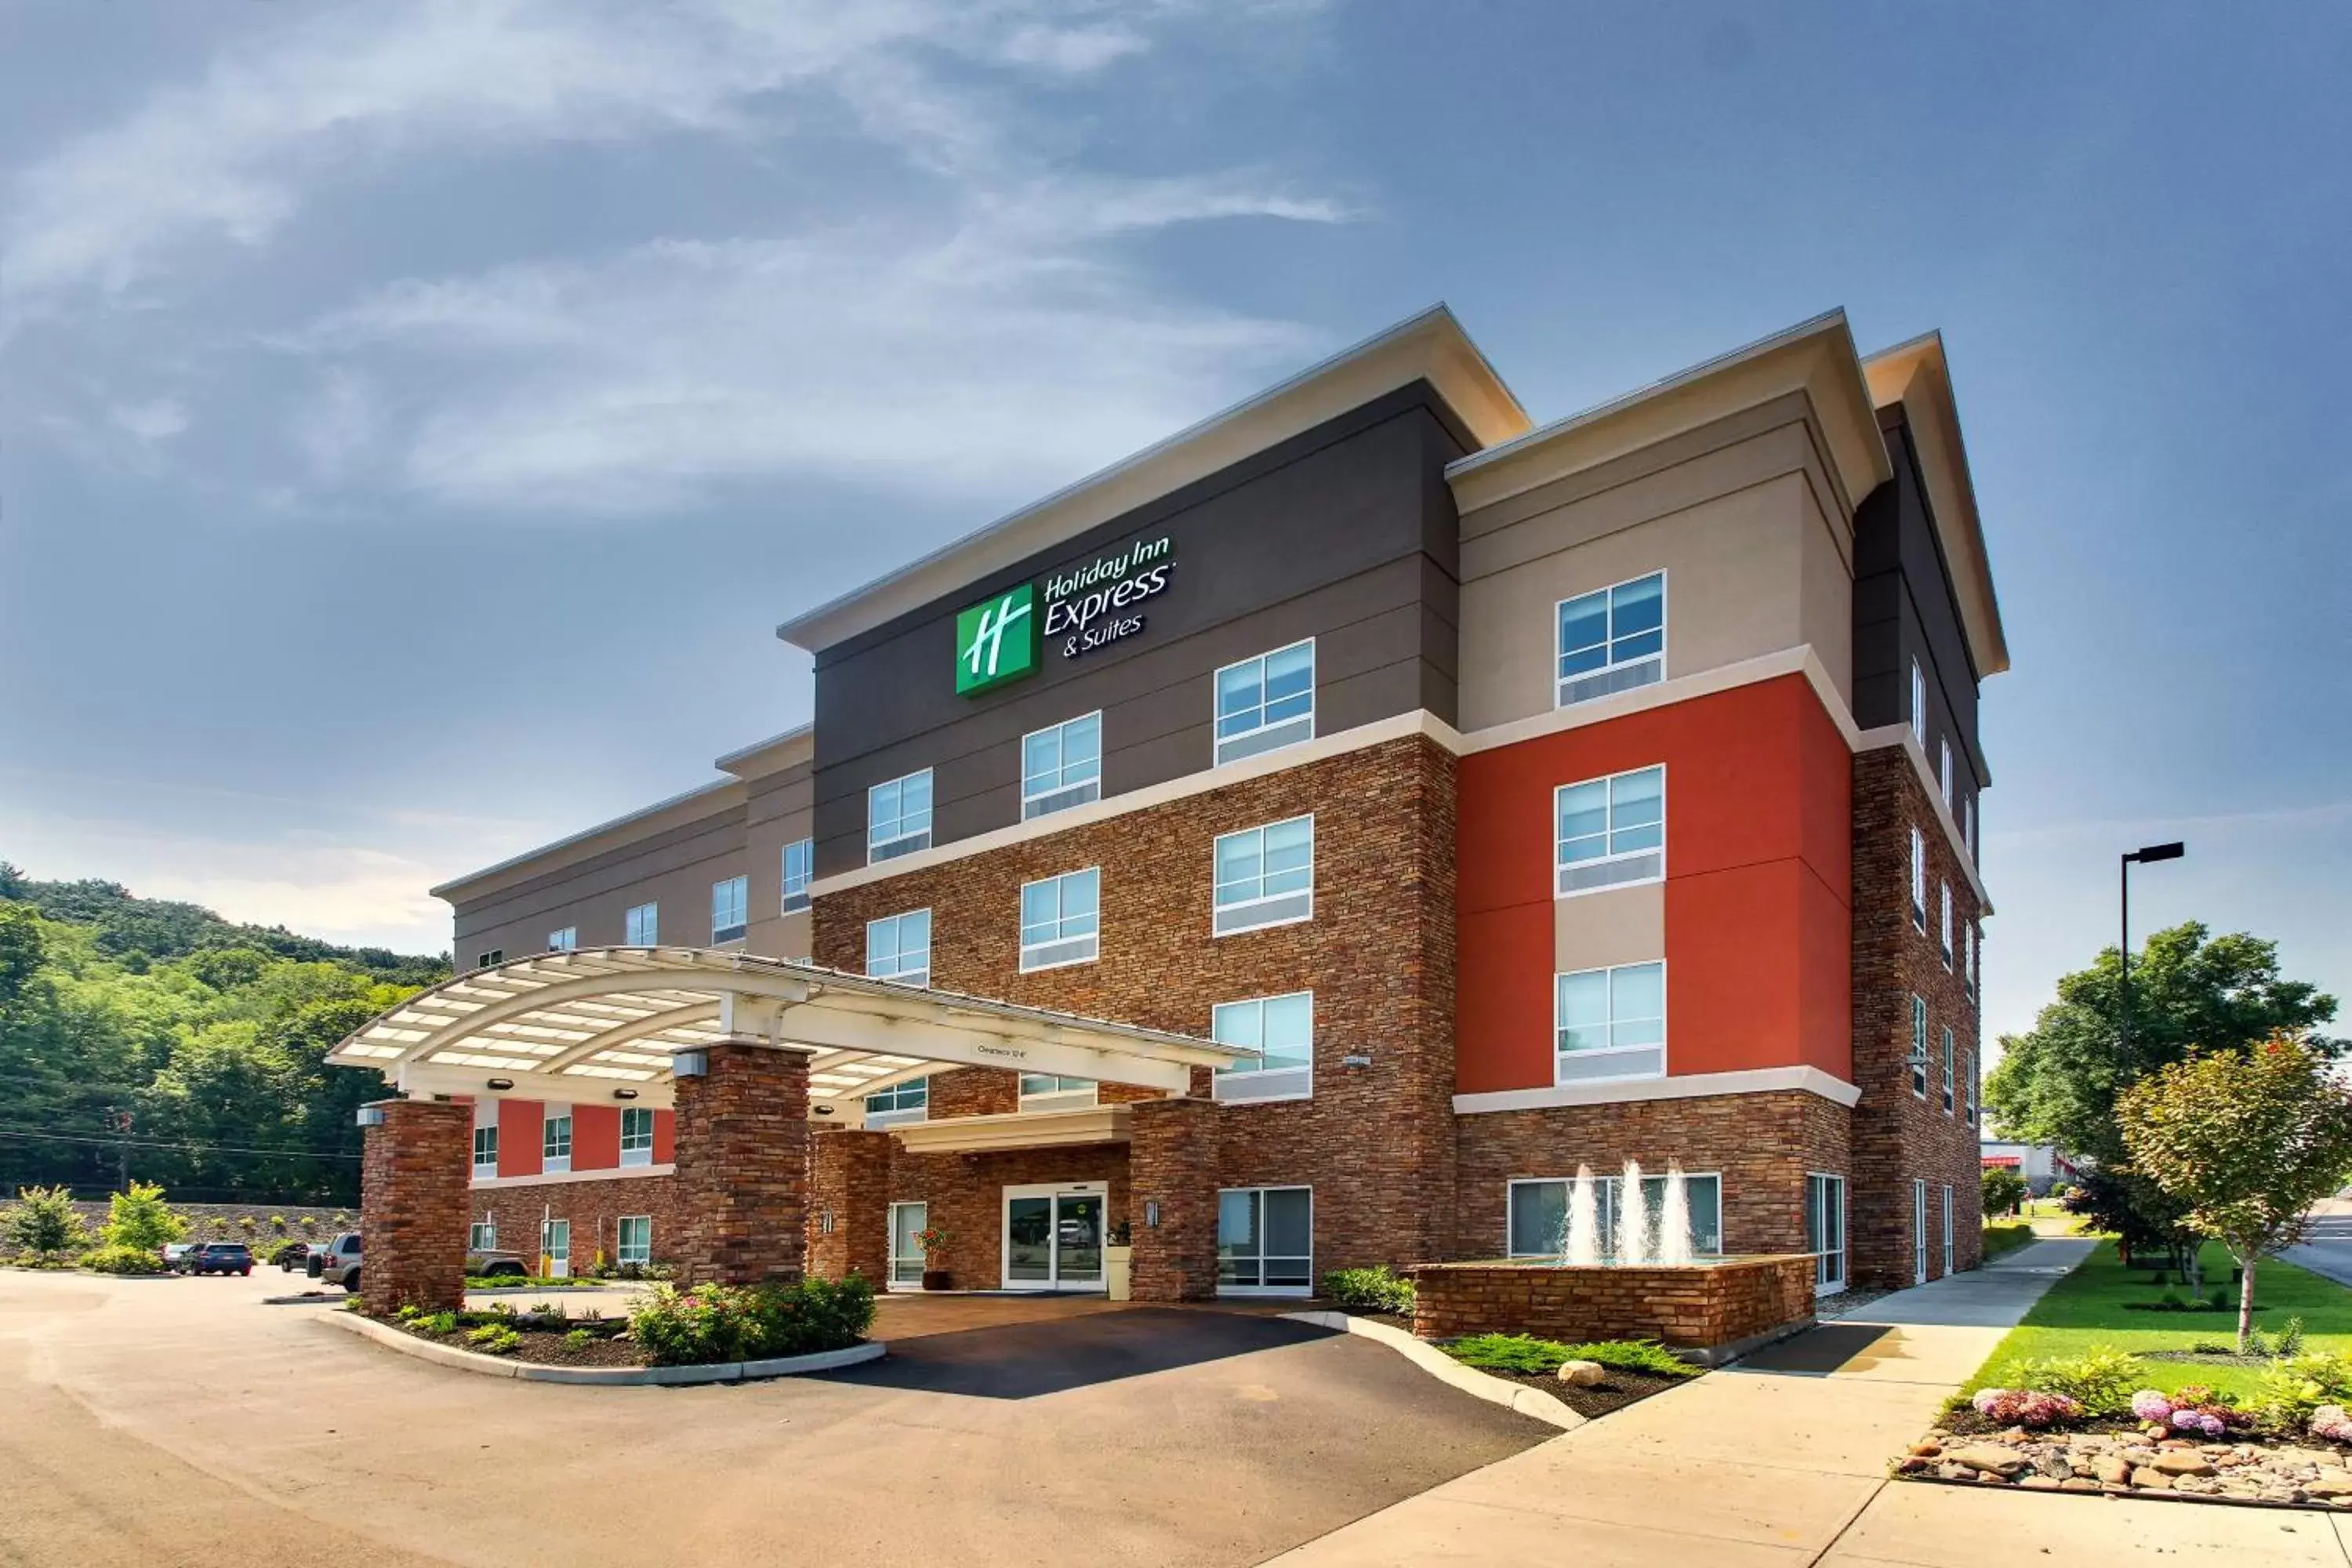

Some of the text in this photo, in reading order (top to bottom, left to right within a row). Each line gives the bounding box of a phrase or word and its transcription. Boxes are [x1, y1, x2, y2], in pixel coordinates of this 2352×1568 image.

[1044, 537, 1169, 602] Holiday Inn
[1044, 565, 1169, 636] Express
[1063, 615, 1142, 657] & Suites
